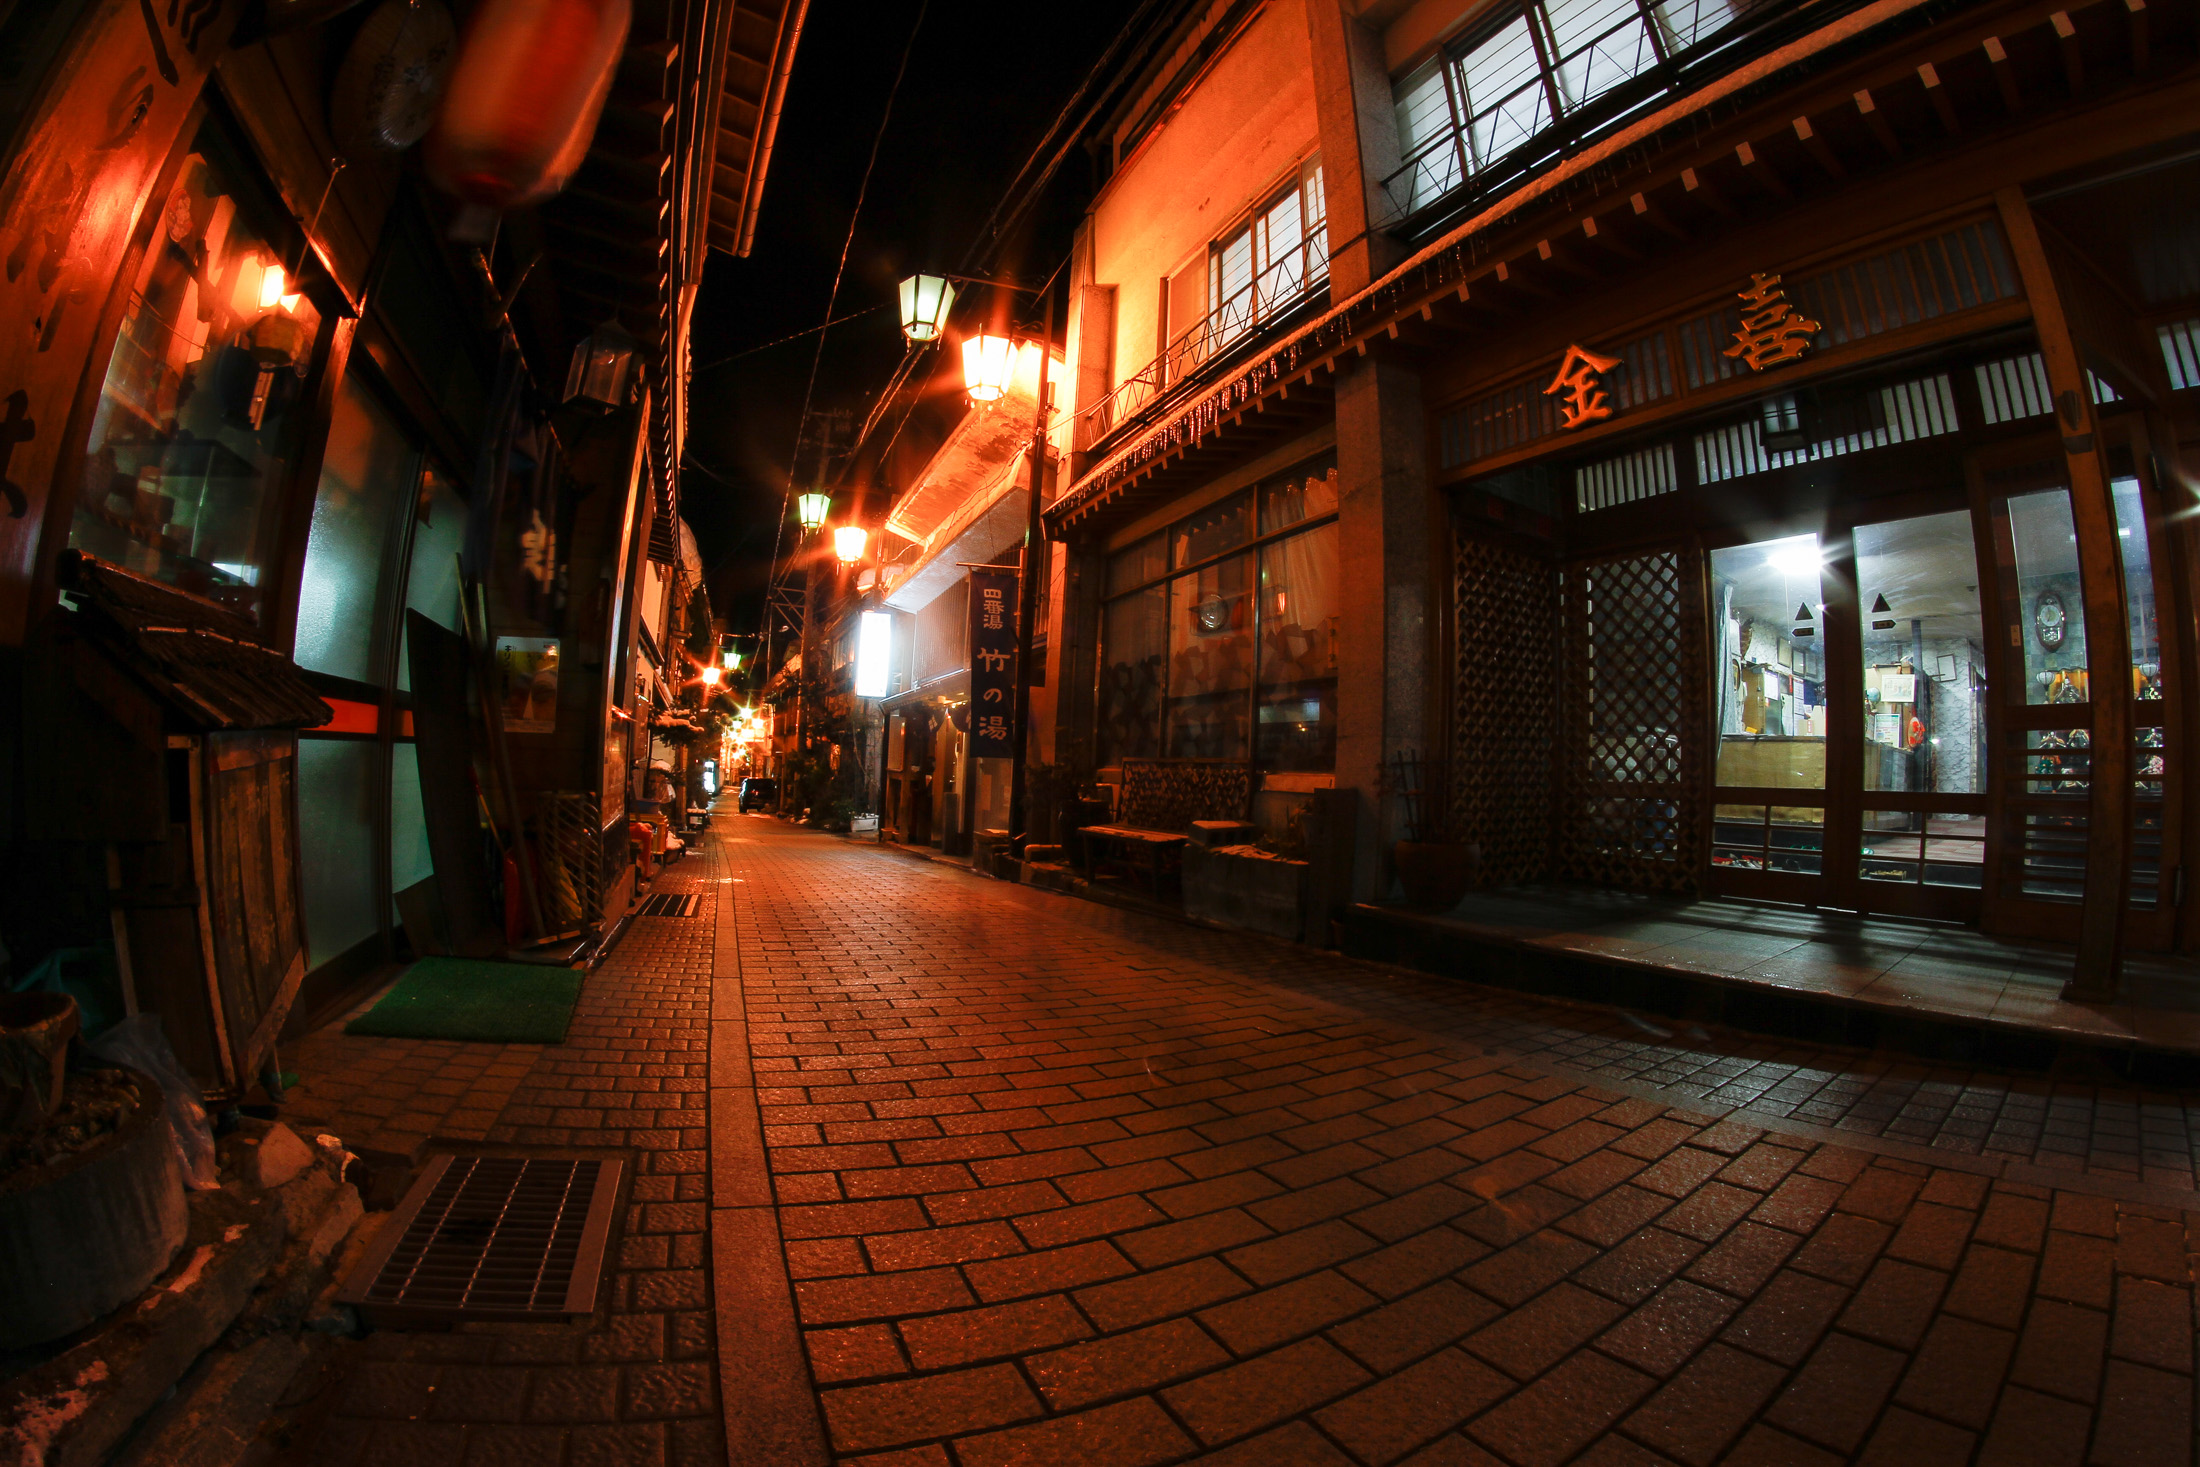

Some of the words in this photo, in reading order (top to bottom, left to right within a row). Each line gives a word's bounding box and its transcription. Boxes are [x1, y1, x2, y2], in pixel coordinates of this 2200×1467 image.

[984, 588, 1004, 629] 四番湯
[977, 648, 1011, 740] 竹の湯
